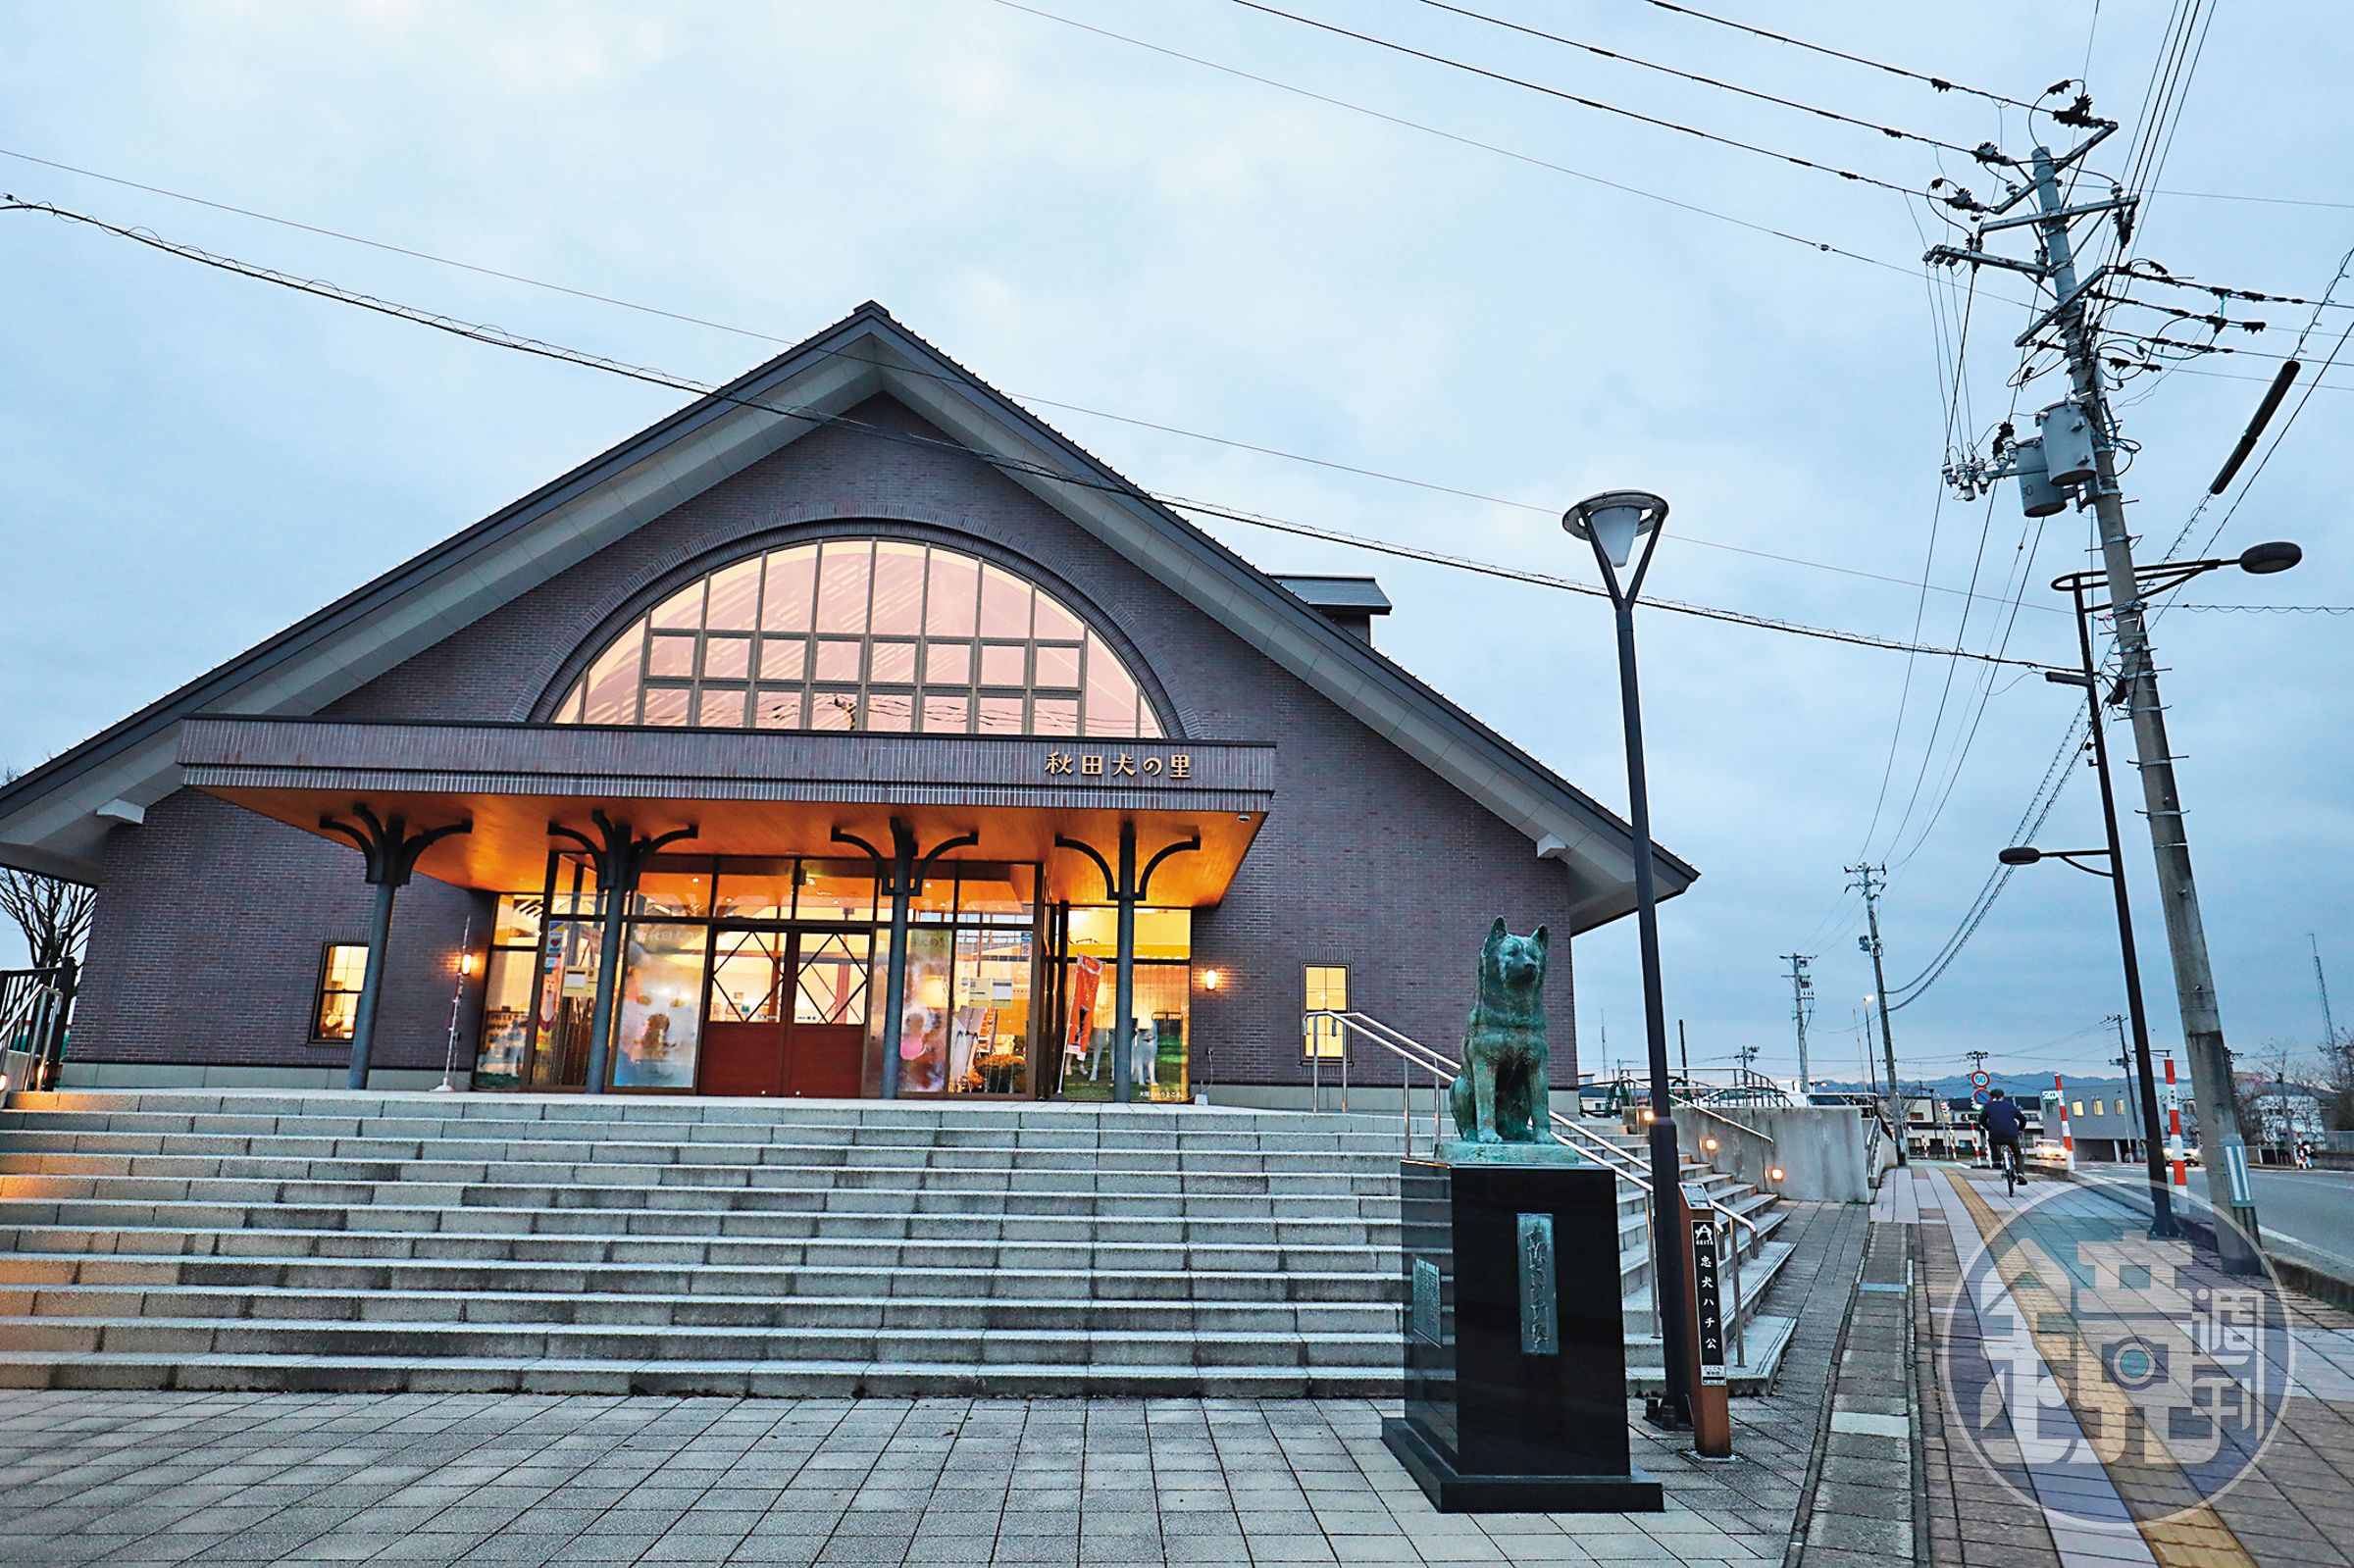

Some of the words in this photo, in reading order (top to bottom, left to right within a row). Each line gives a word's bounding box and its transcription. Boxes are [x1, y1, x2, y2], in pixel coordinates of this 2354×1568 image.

[1045, 750, 1191, 780] 秋田犬の里
[1974, 1075, 1986, 1084] 50
[1700, 1255, 1717, 1350] 忠犬ハチ公
